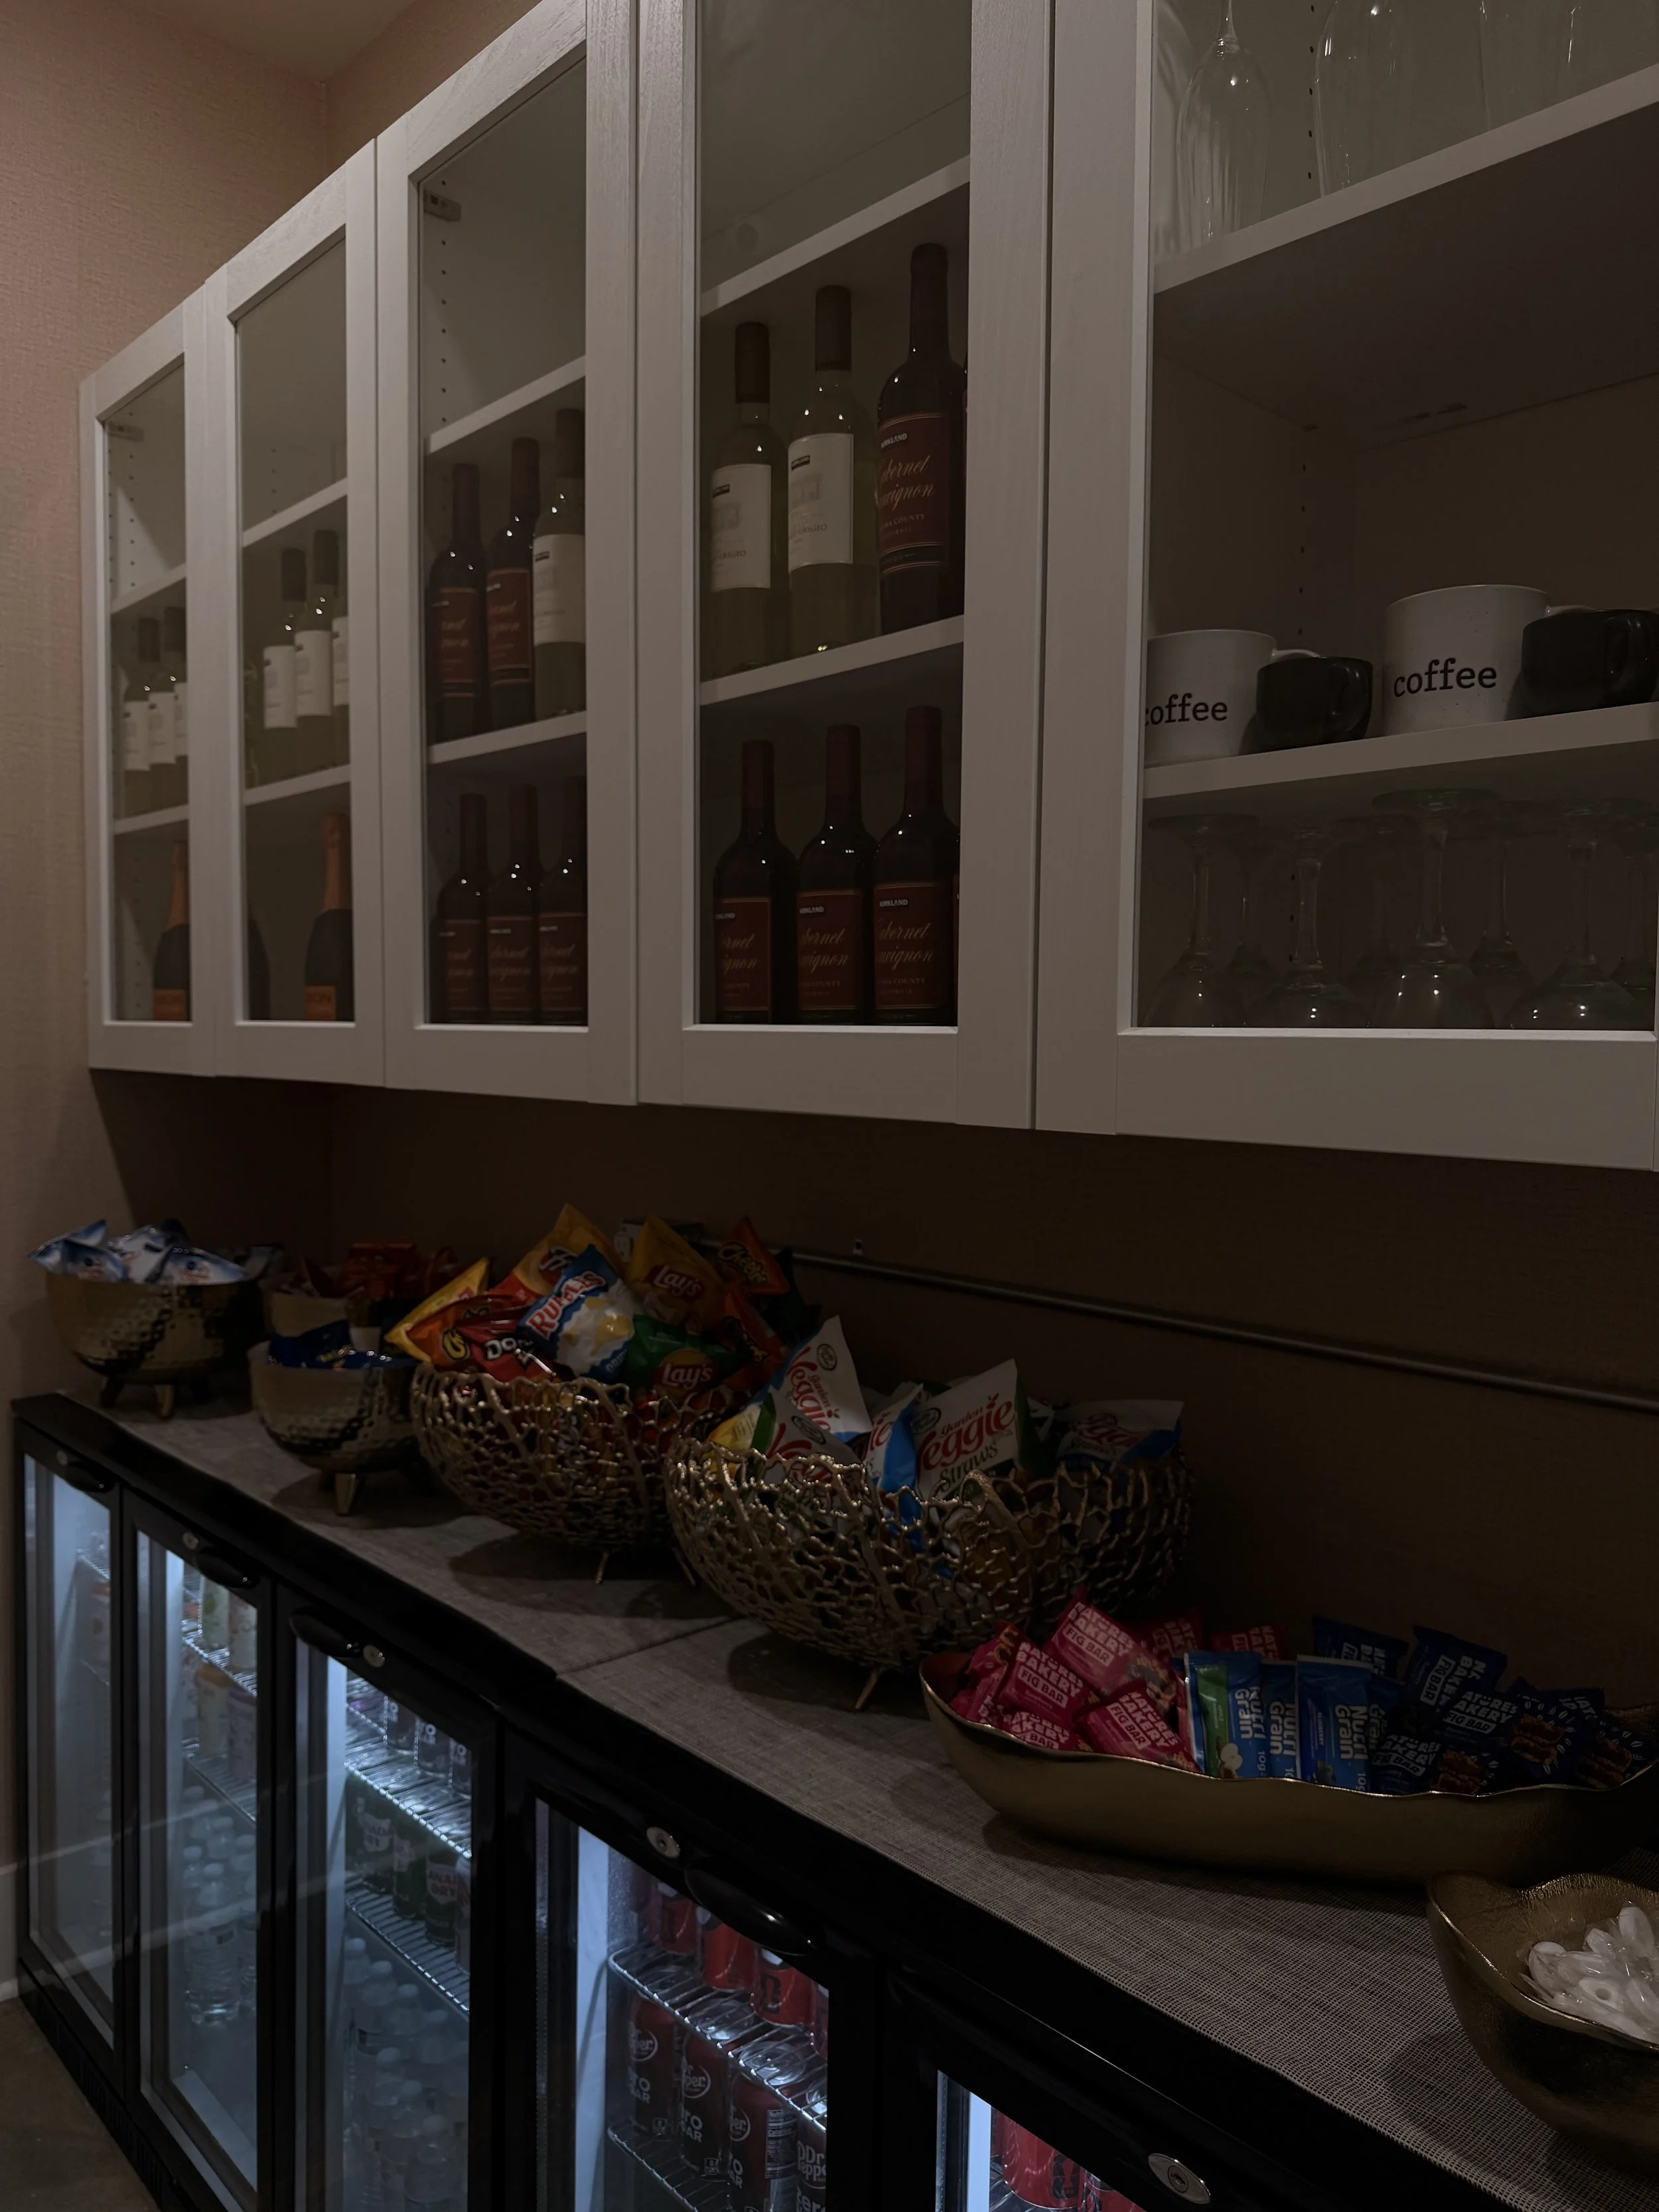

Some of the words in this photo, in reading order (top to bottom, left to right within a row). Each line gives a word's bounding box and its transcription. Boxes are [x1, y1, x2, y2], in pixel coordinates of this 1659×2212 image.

[1394, 658, 1496, 697] coffee
[652, 1264, 703, 1297] Lay's
[662, 1363, 714, 1390] Lay's
[1066, 1627, 1086, 1646] FIG
[1085, 1641, 1110, 1663] BAR
[1015, 1650, 1081, 1698] BAKERY
[1435, 1659, 1452, 1677] FIG
[1021, 1669, 1040, 1687] FIG
[1041, 1684, 1065, 1704] BAR
[1423, 1674, 1441, 1700] BAR
[1110, 1706, 1129, 1724] FIG
[1125, 1724, 1146, 1745] BAR
[1118, 1694, 1171, 1747] BAKERY
[1234, 1688, 1254, 1739] Grain
[1269, 1700, 1285, 1755] Grain
[1283, 1702, 1296, 1756] Nutri
[1445, 1712, 1465, 1725] FIG
[1465, 1719, 1491, 1732] BAR
[1453, 1700, 1514, 1724] AKERY
[1010, 1720, 1070, 1744] AKERY
[1029, 1732, 1055, 1749] BAR
[1334, 1704, 1354, 1760] Grain
[1349, 1705, 1369, 1760] Nutri
[1380, 1739, 1437, 1766] AKERY
[686, 2075, 707, 2089] per
